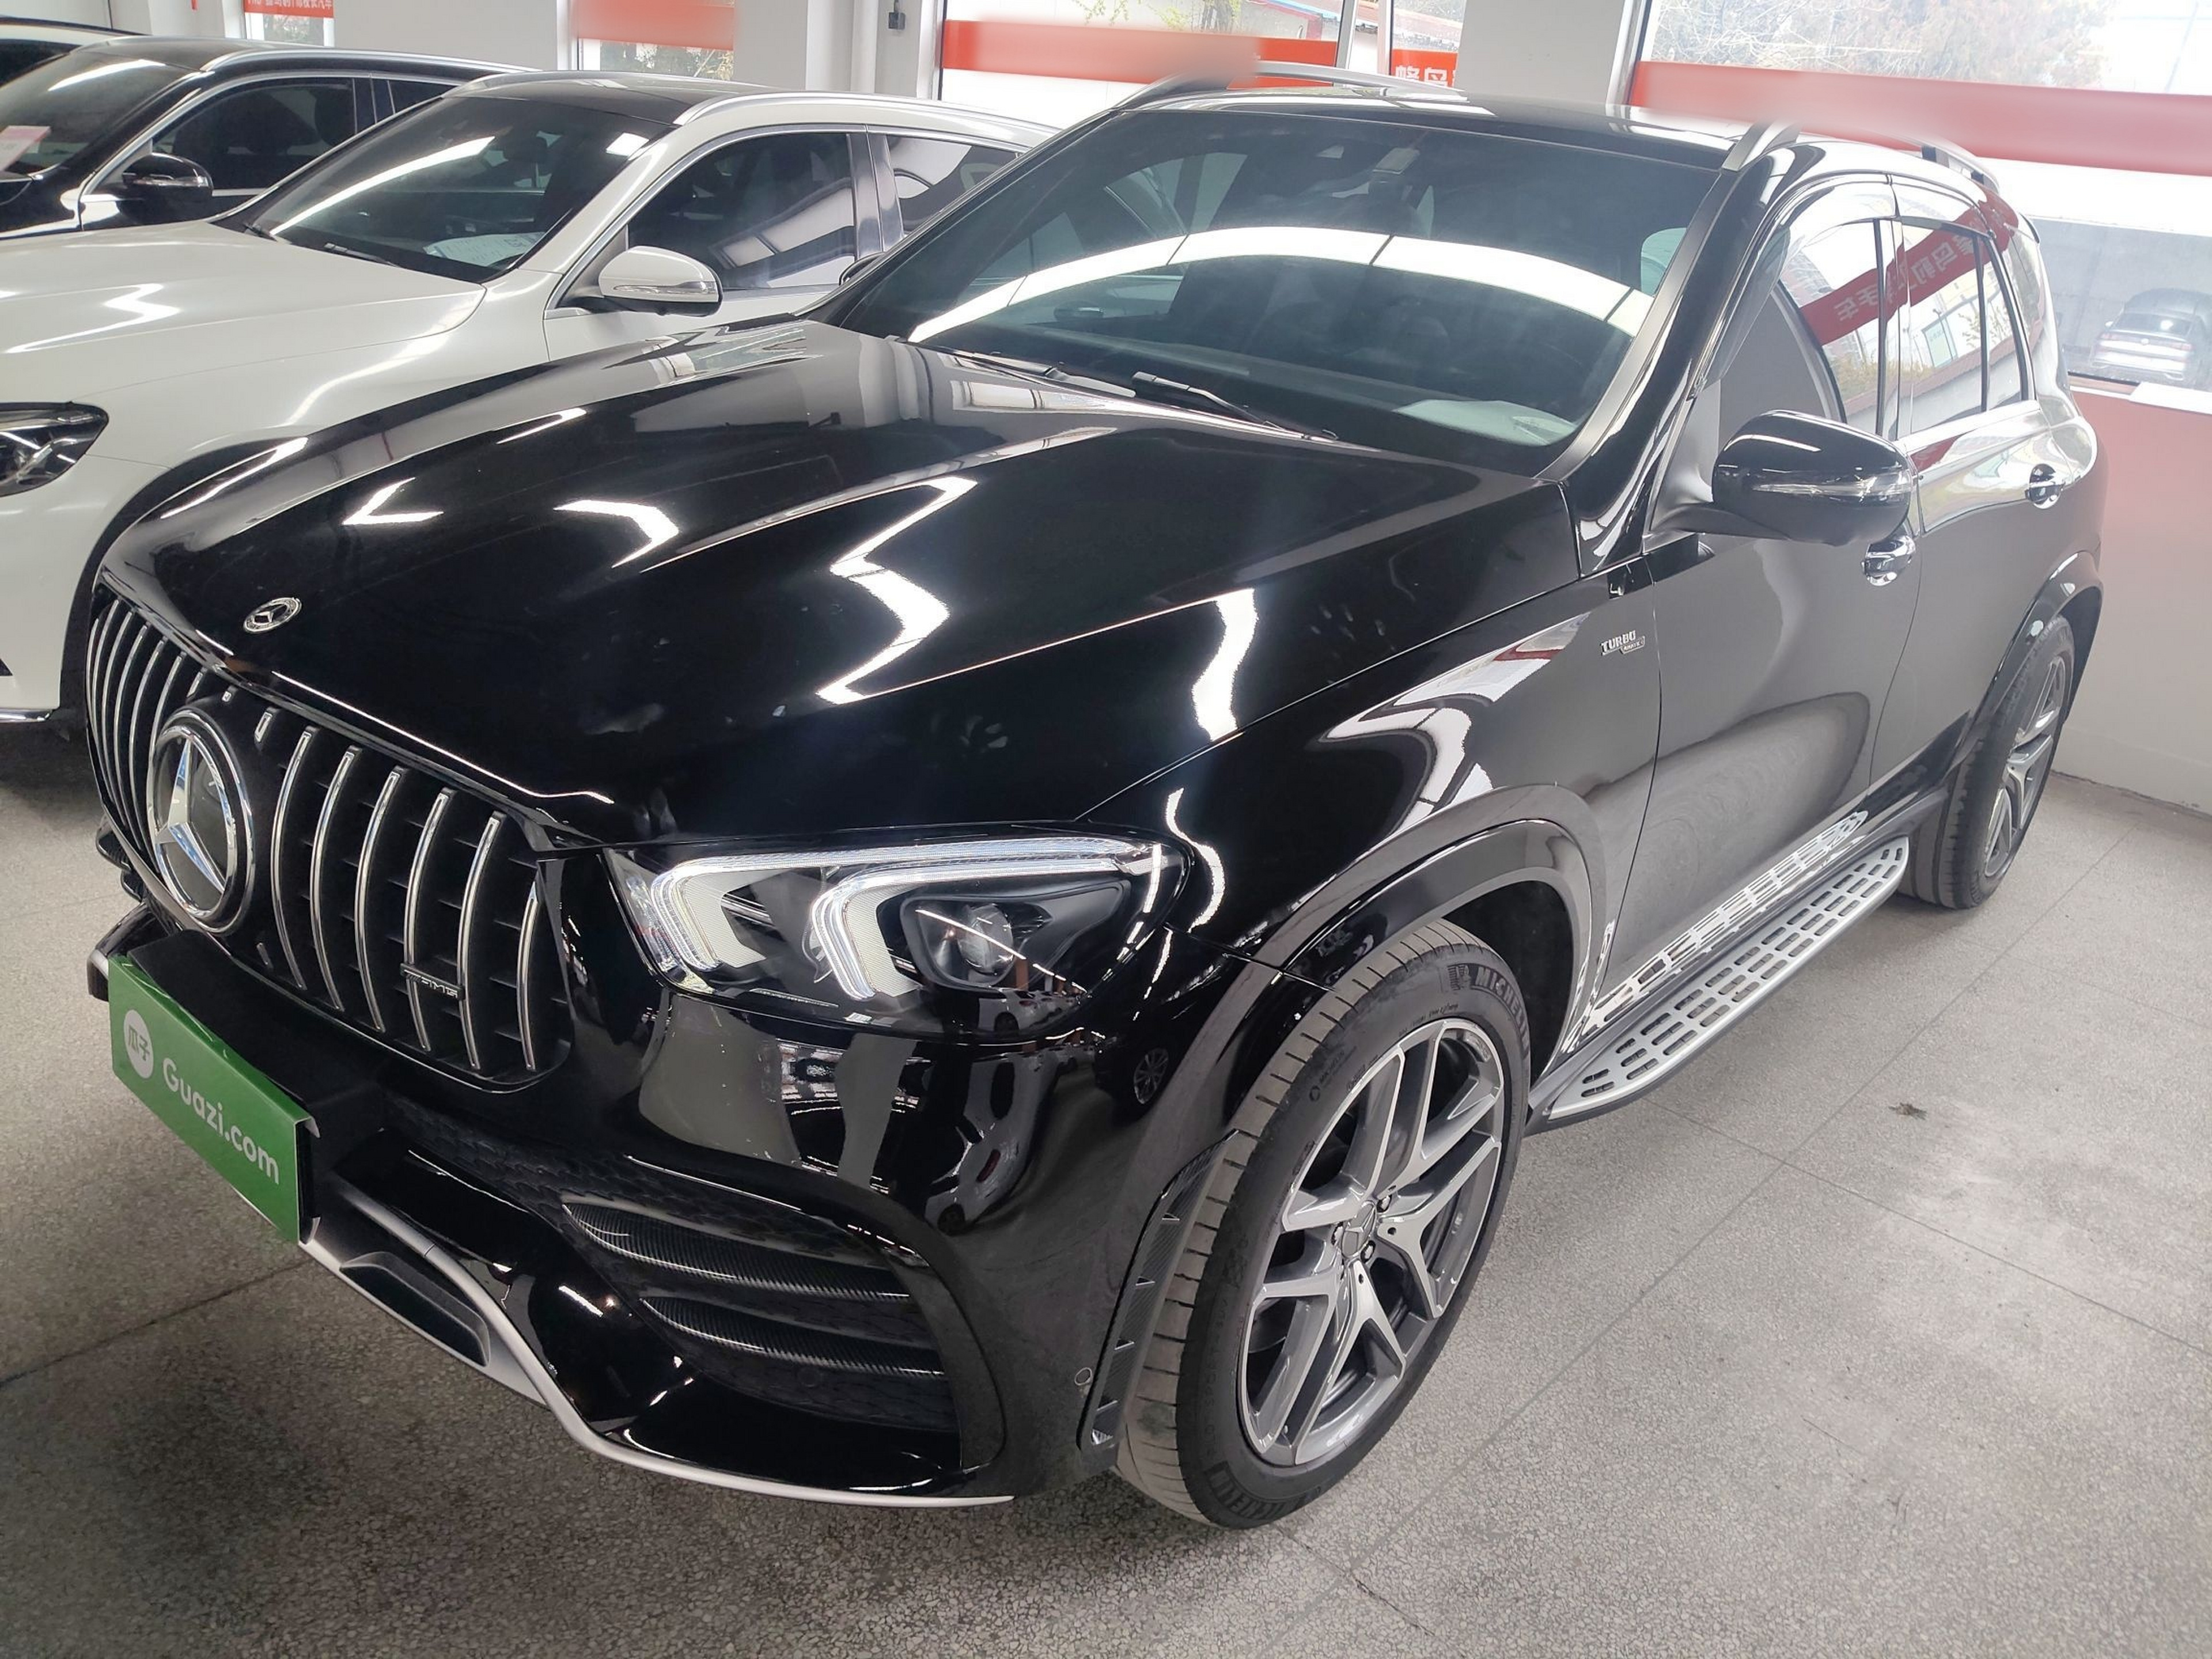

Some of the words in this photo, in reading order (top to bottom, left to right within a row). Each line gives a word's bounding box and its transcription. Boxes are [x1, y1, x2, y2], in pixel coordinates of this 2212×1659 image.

[1601, 630, 1636, 652] TURBO
[421, 976, 457, 998] AMG
[1474, 965, 1530, 1051] MICHELIN
[128, 1025, 150, 1061] 瓜子
[163, 1058, 279, 1185] Guazi.com
